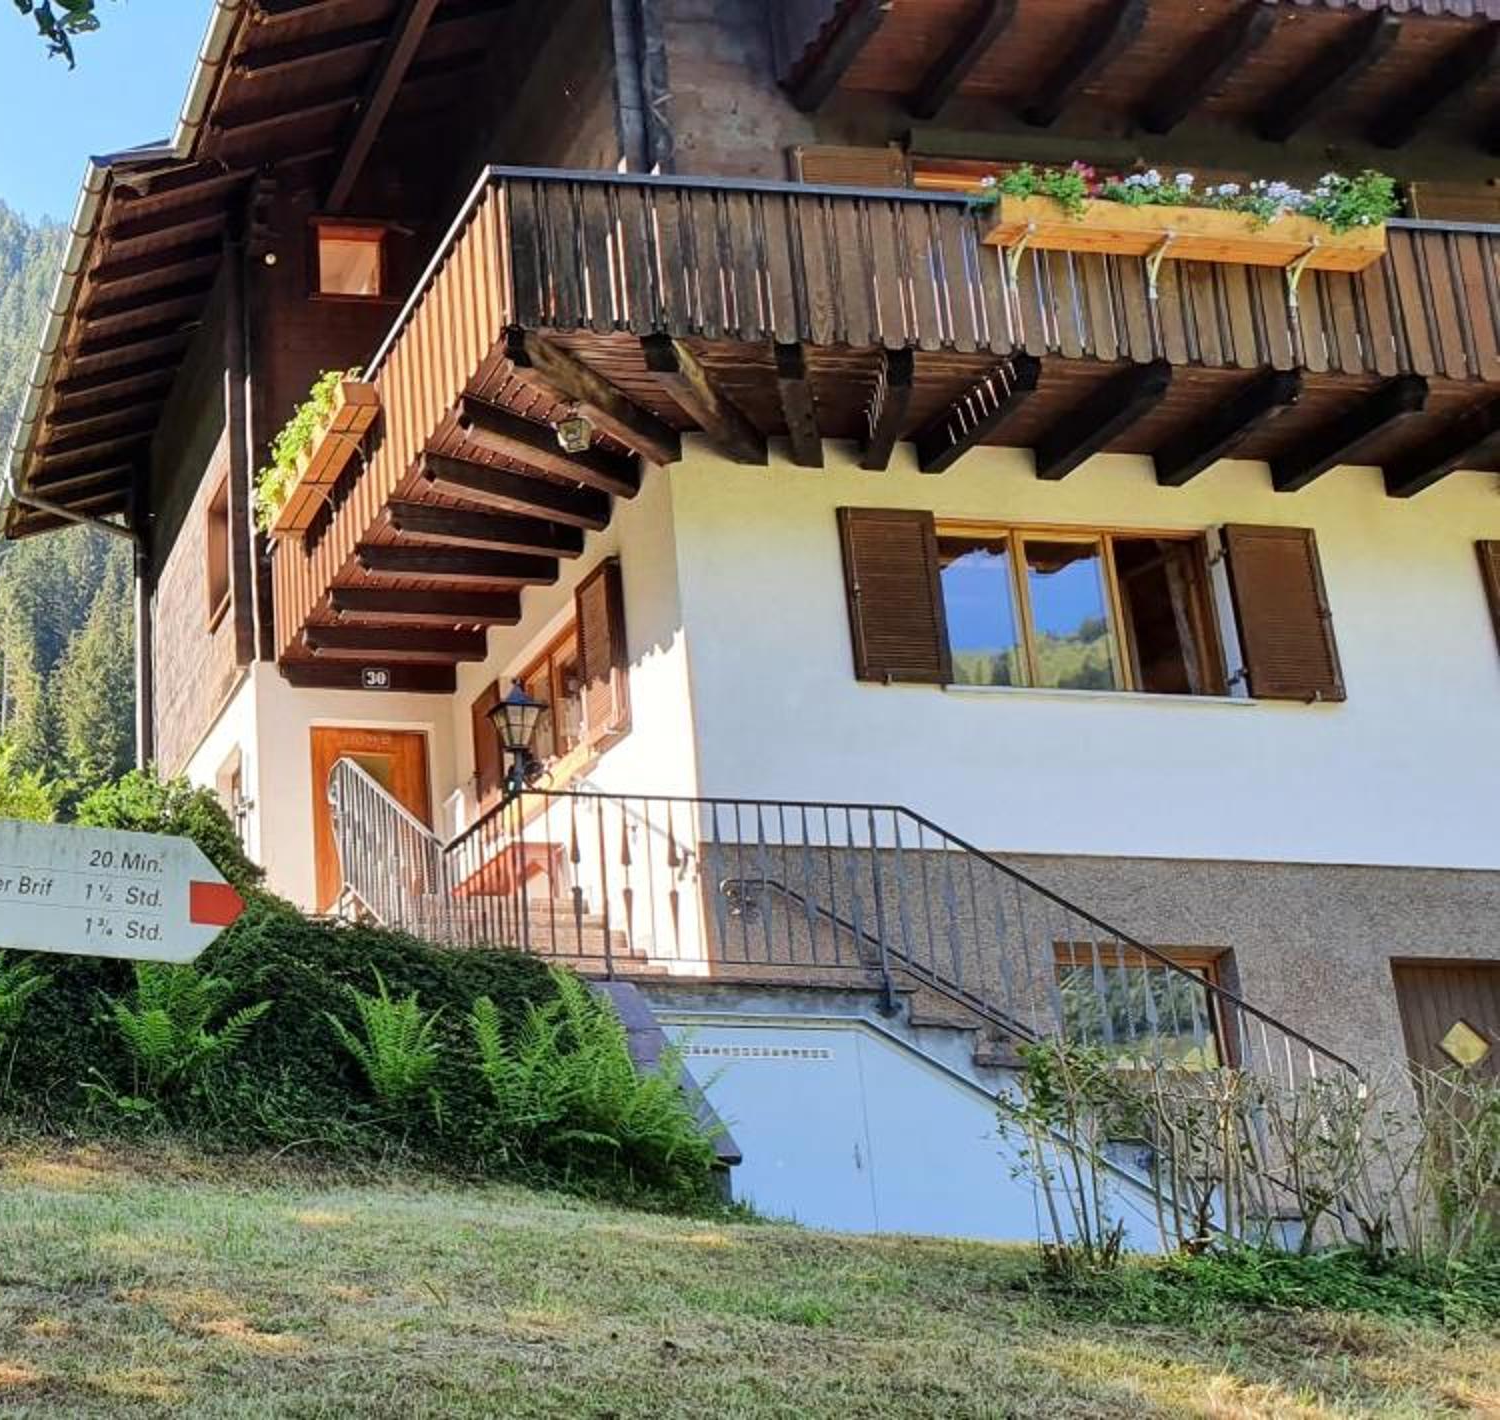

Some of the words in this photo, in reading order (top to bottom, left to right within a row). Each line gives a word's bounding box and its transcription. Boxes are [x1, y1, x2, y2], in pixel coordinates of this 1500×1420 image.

[367, 671, 386, 685] 30
[121, 853, 164, 873] Min.
[19, 875, 53, 896] Brif
[125, 887, 163, 907] Std.
[125, 921, 163, 941] Std.
